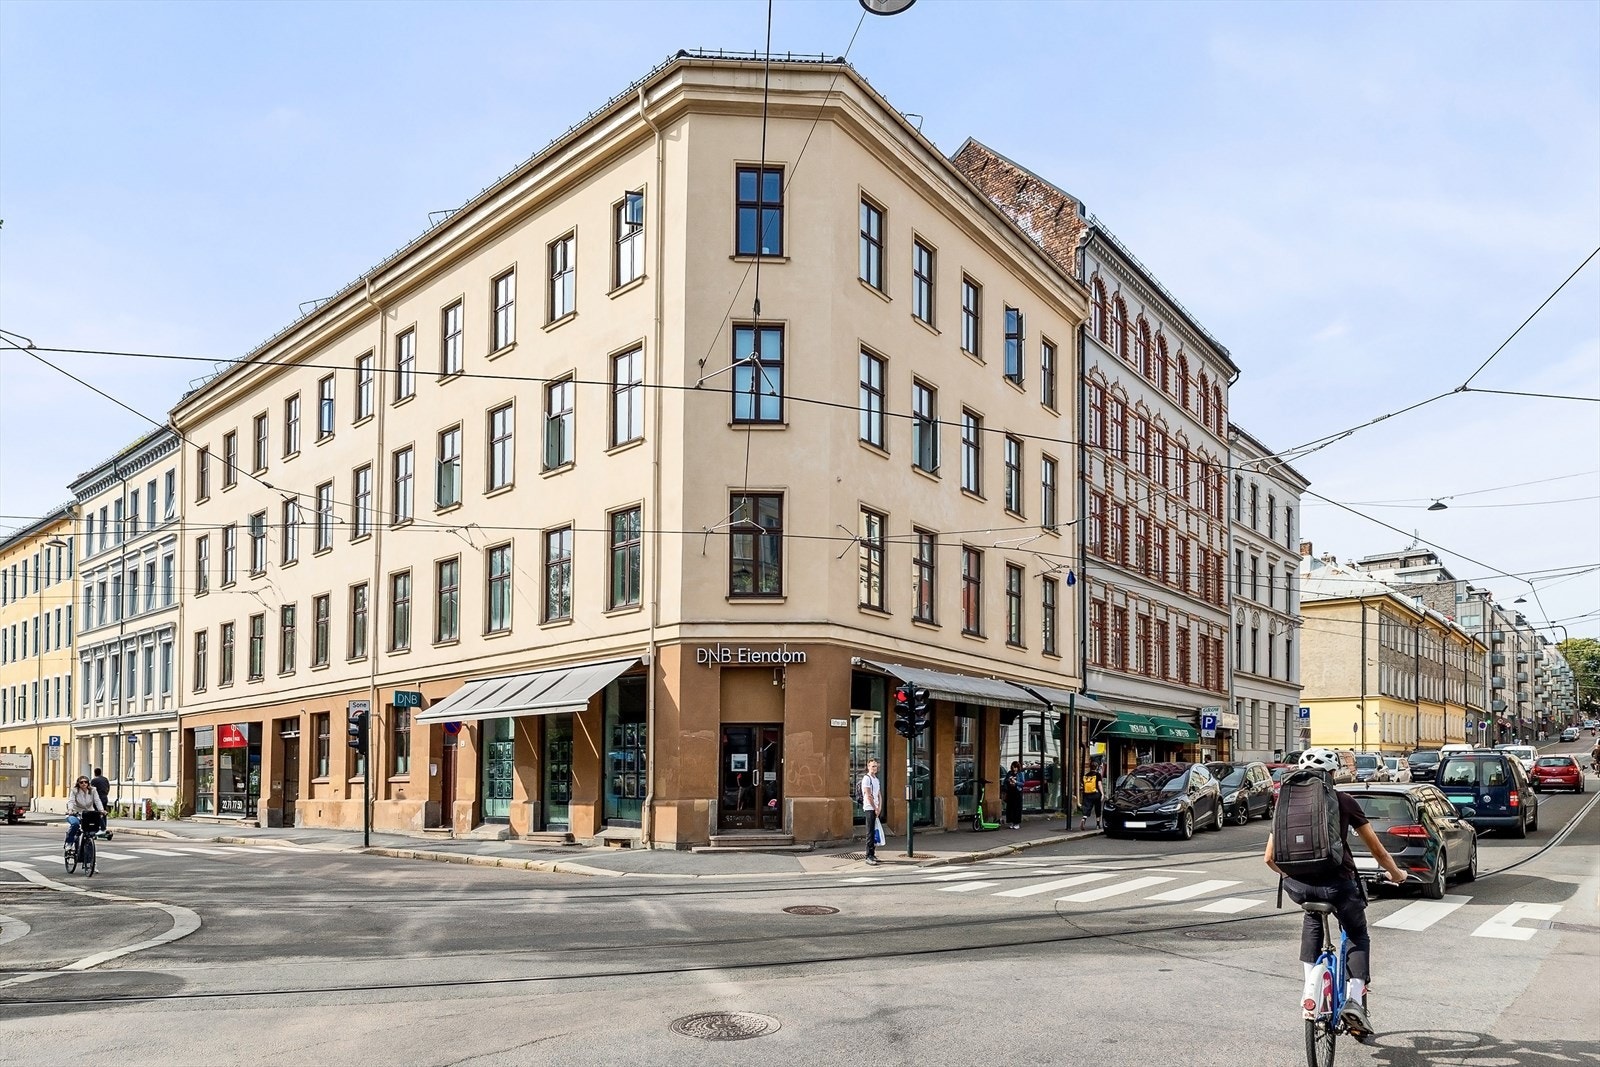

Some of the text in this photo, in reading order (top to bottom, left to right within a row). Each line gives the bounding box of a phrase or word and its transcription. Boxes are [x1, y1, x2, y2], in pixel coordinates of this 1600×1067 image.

[696, 643, 807, 669] DNB Eiendom
[397, 693, 418, 706] DNB
[1302, 709, 1308, 717] P
[1205, 717, 1214, 728] P
[51, 737, 58, 745] P
